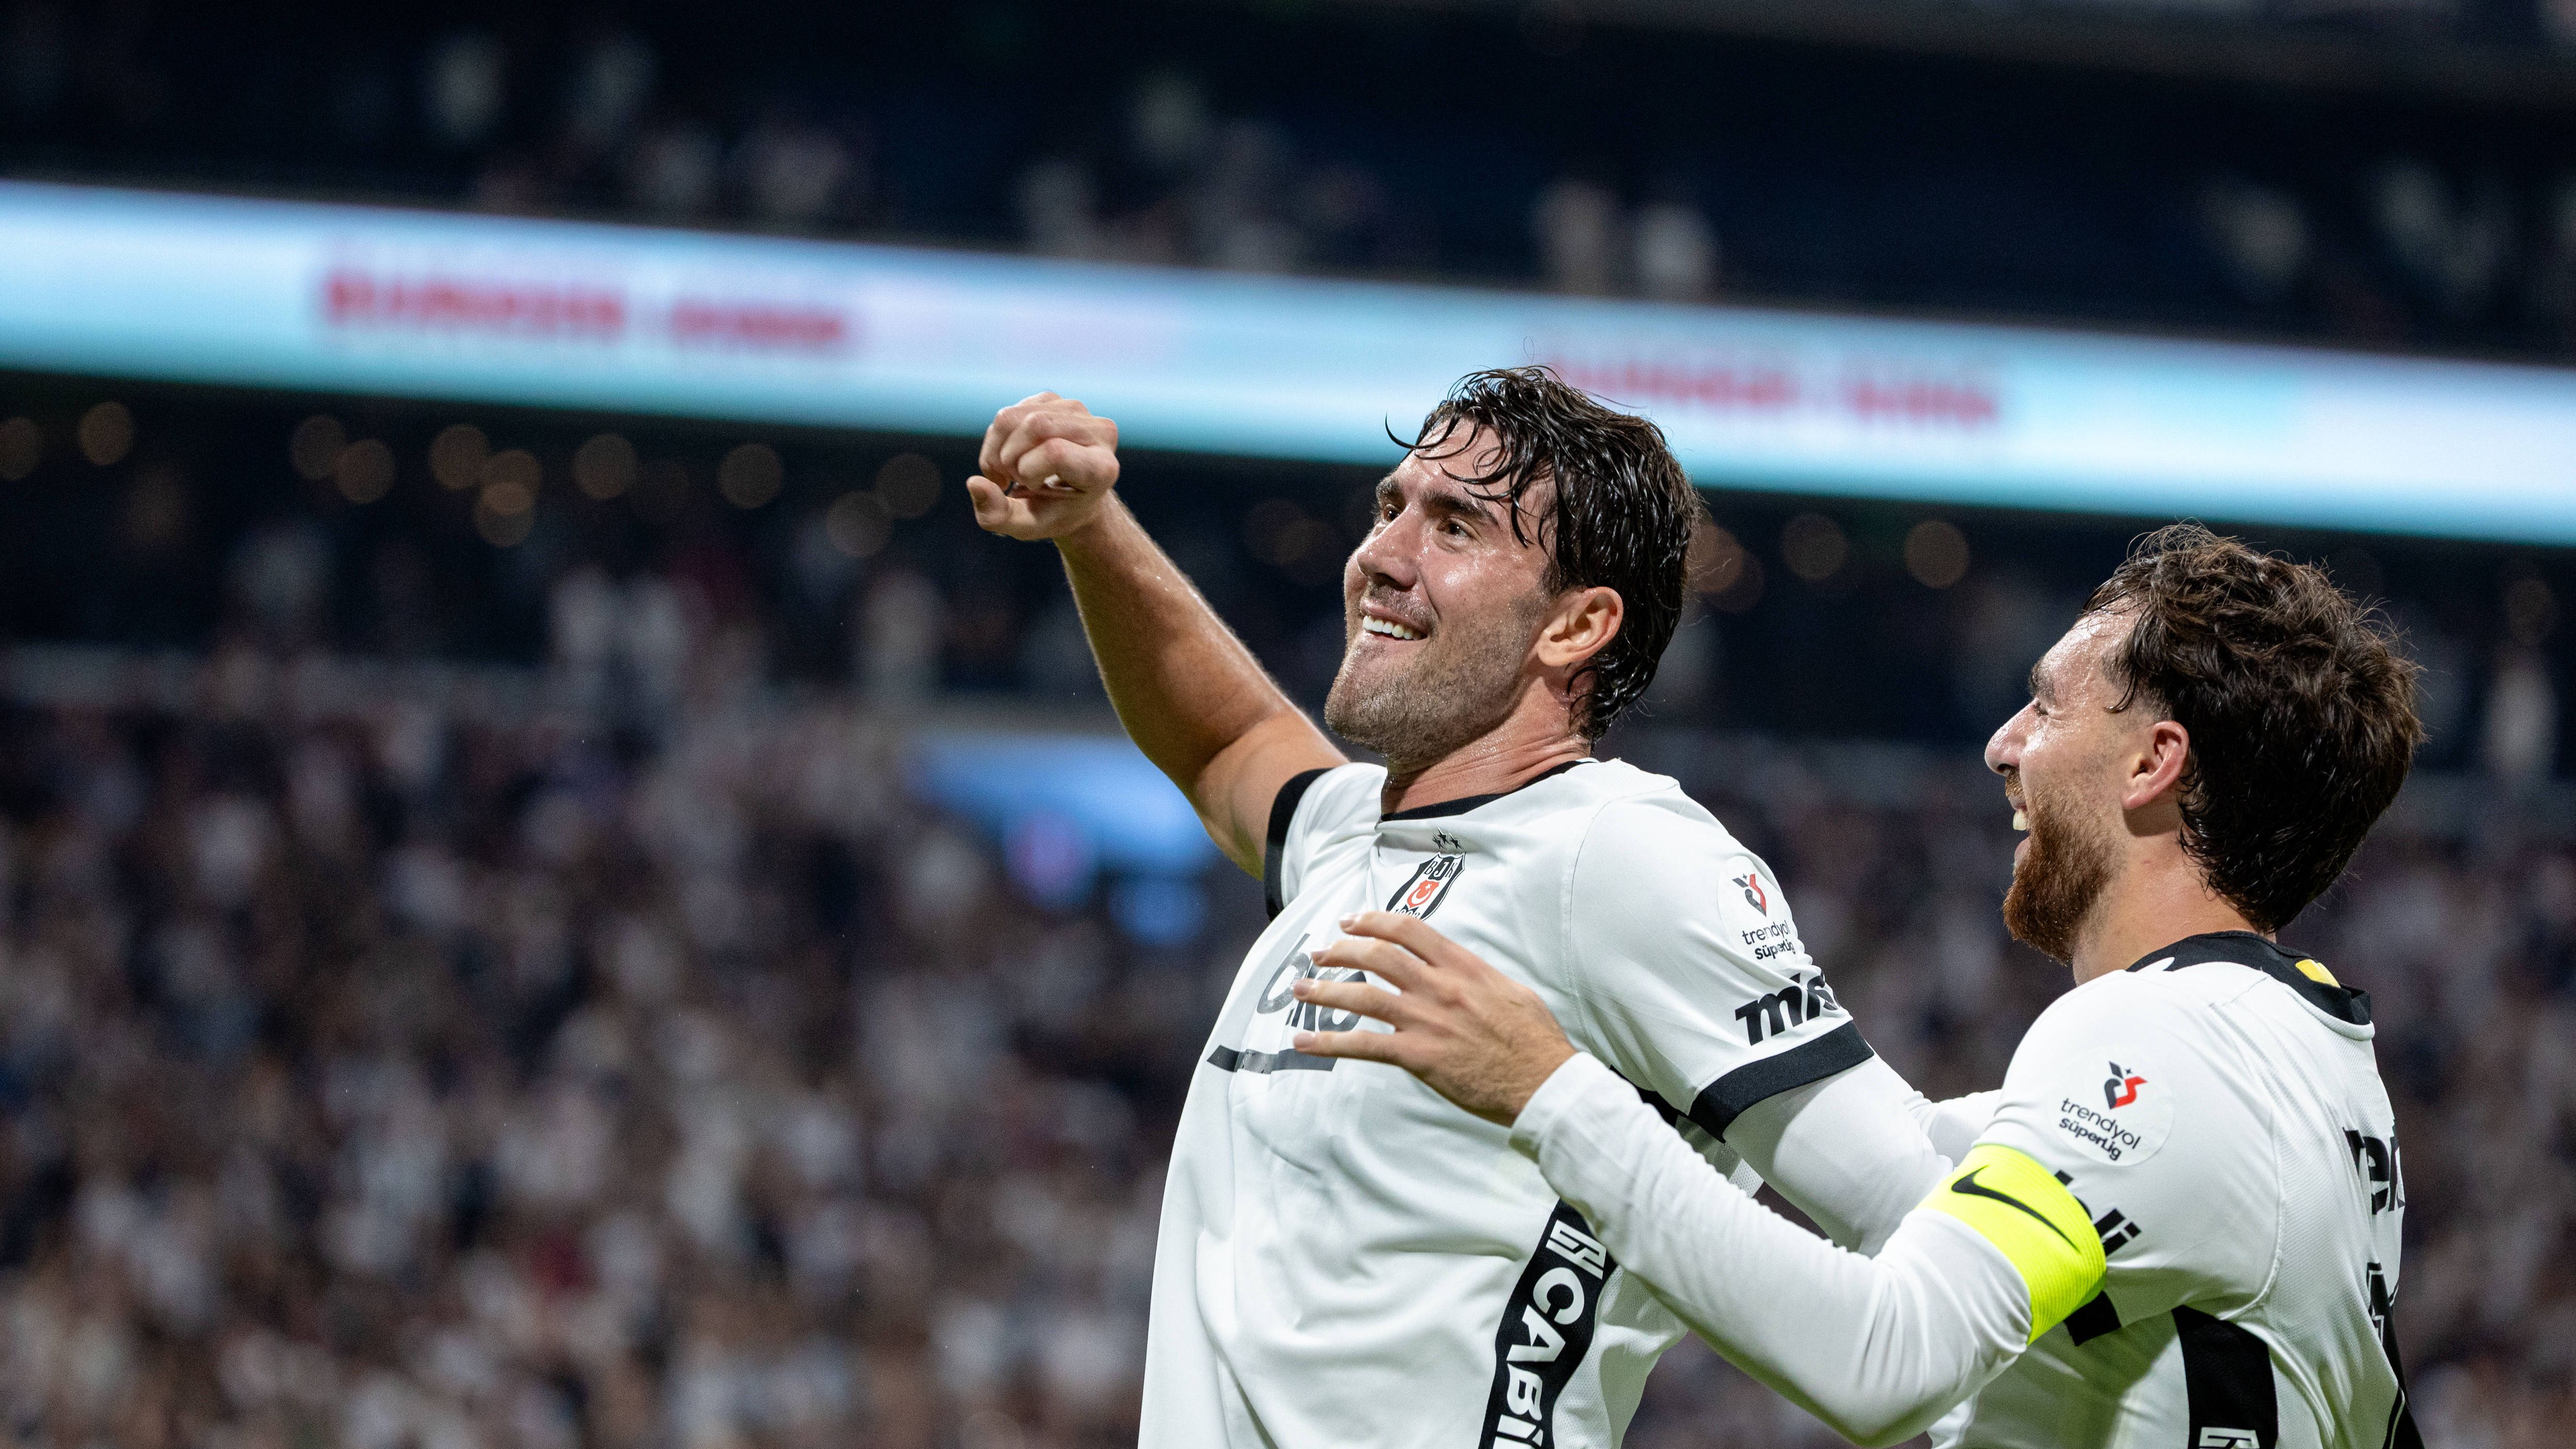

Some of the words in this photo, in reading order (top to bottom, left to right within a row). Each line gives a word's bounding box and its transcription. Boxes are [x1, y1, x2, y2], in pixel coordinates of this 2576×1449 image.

[1423, 861, 1458, 878] BJK
[1742, 919, 1791, 945] trendyol
[2060, 1098, 2141, 1149] trendyol
